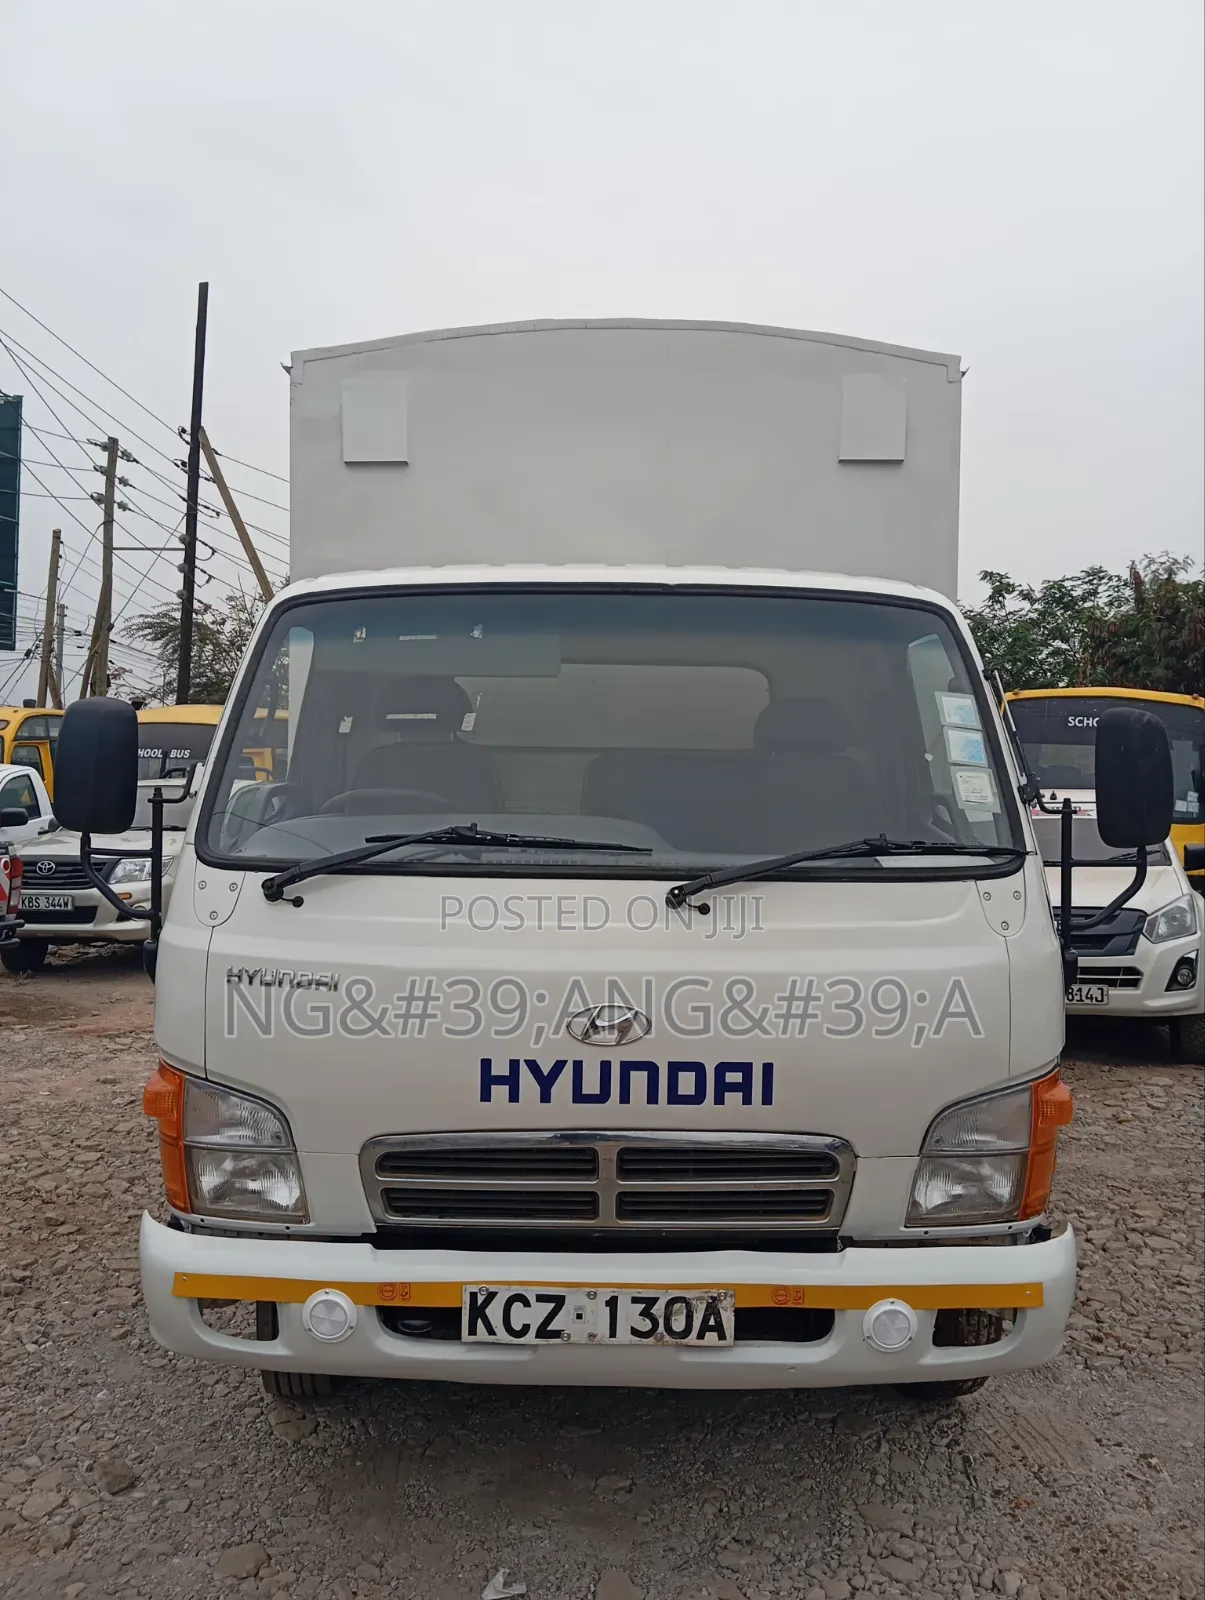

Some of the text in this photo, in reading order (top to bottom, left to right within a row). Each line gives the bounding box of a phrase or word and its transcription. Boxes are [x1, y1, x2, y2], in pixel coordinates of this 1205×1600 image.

[170, 749, 191, 758] BUS
[21, 896, 70, 909] KBS 344W
[227, 966, 340, 992] HYUNDAI
[479, 1058, 774, 1106] HYUNDAI
[468, 1291, 566, 1339] KCZ
[604, 1295, 727, 1341] 130A
